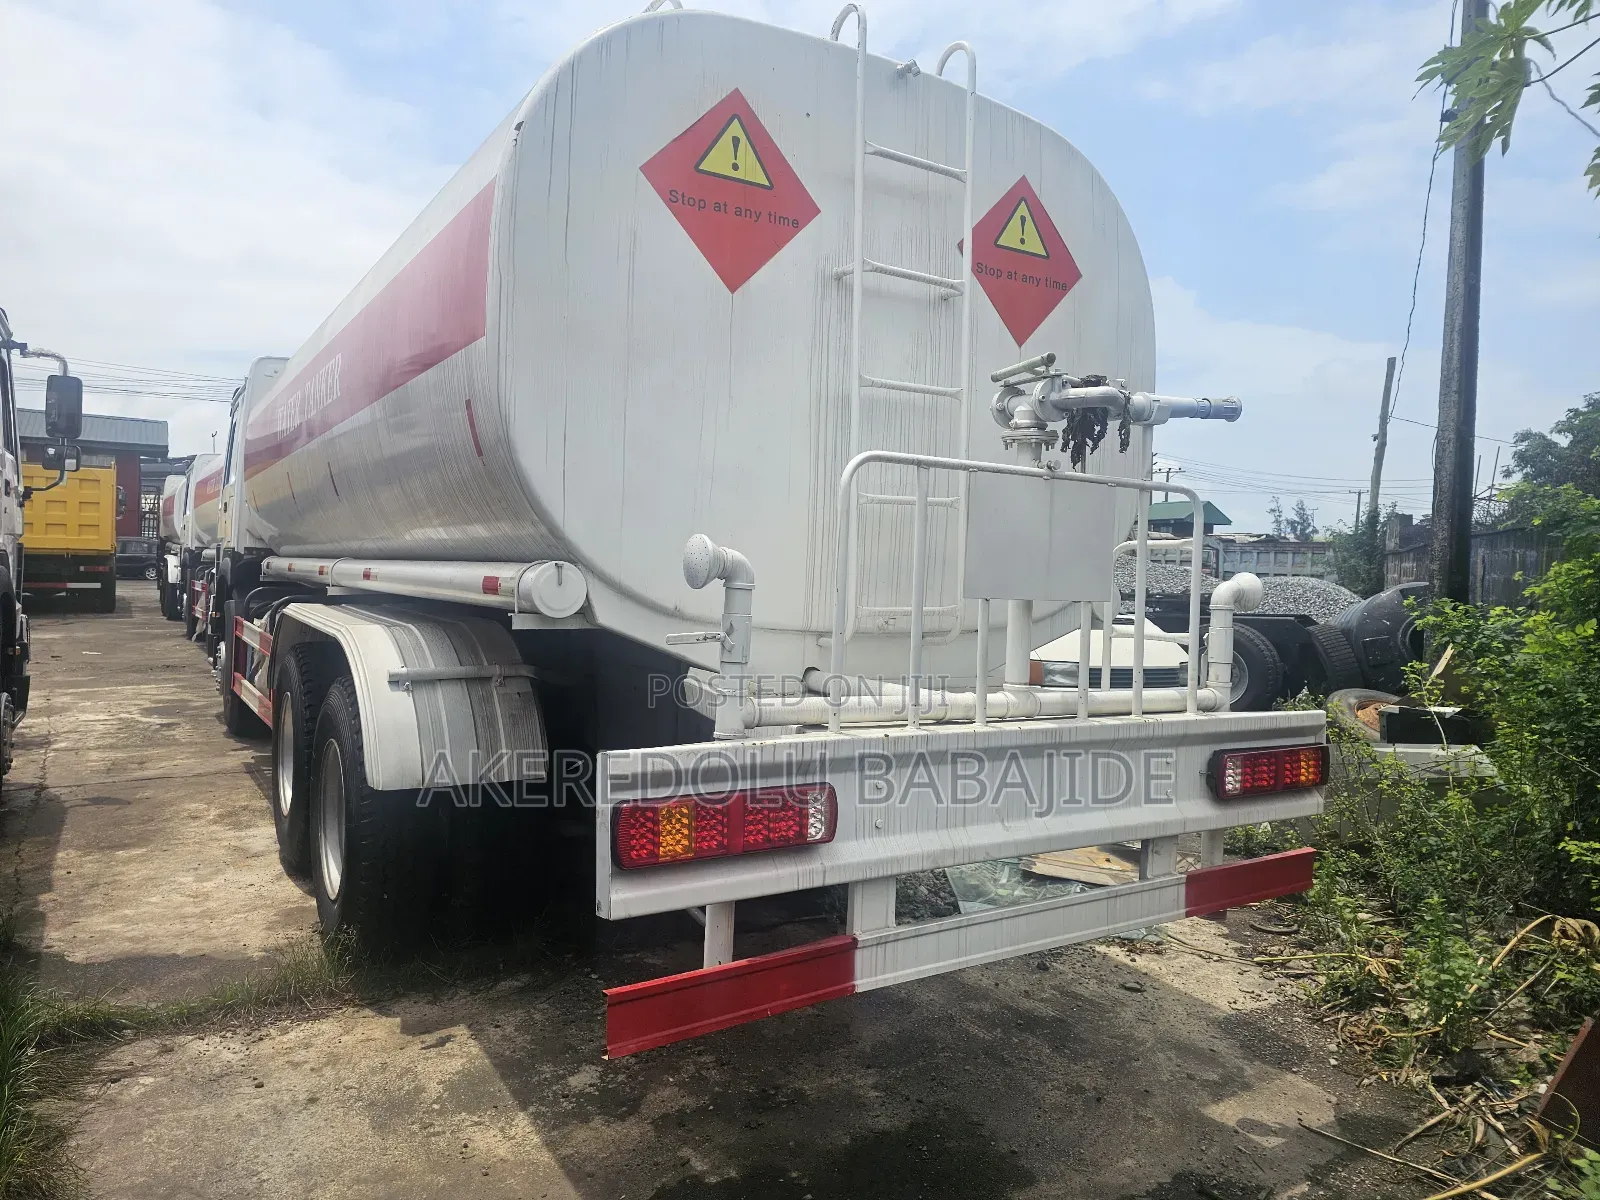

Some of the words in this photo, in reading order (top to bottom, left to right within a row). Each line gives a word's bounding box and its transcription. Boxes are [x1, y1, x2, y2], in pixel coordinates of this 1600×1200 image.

[668, 189, 707, 210] Stop
[713, 200, 729, 214] at
[734, 207, 762, 223] any
[768, 211, 800, 229] time
[976, 262, 1003, 279] Stop
[1006, 270, 1018, 281] at
[1022, 274, 1041, 287] any
[1045, 277, 1068, 291] time
[304, 352, 342, 420] TANKER
